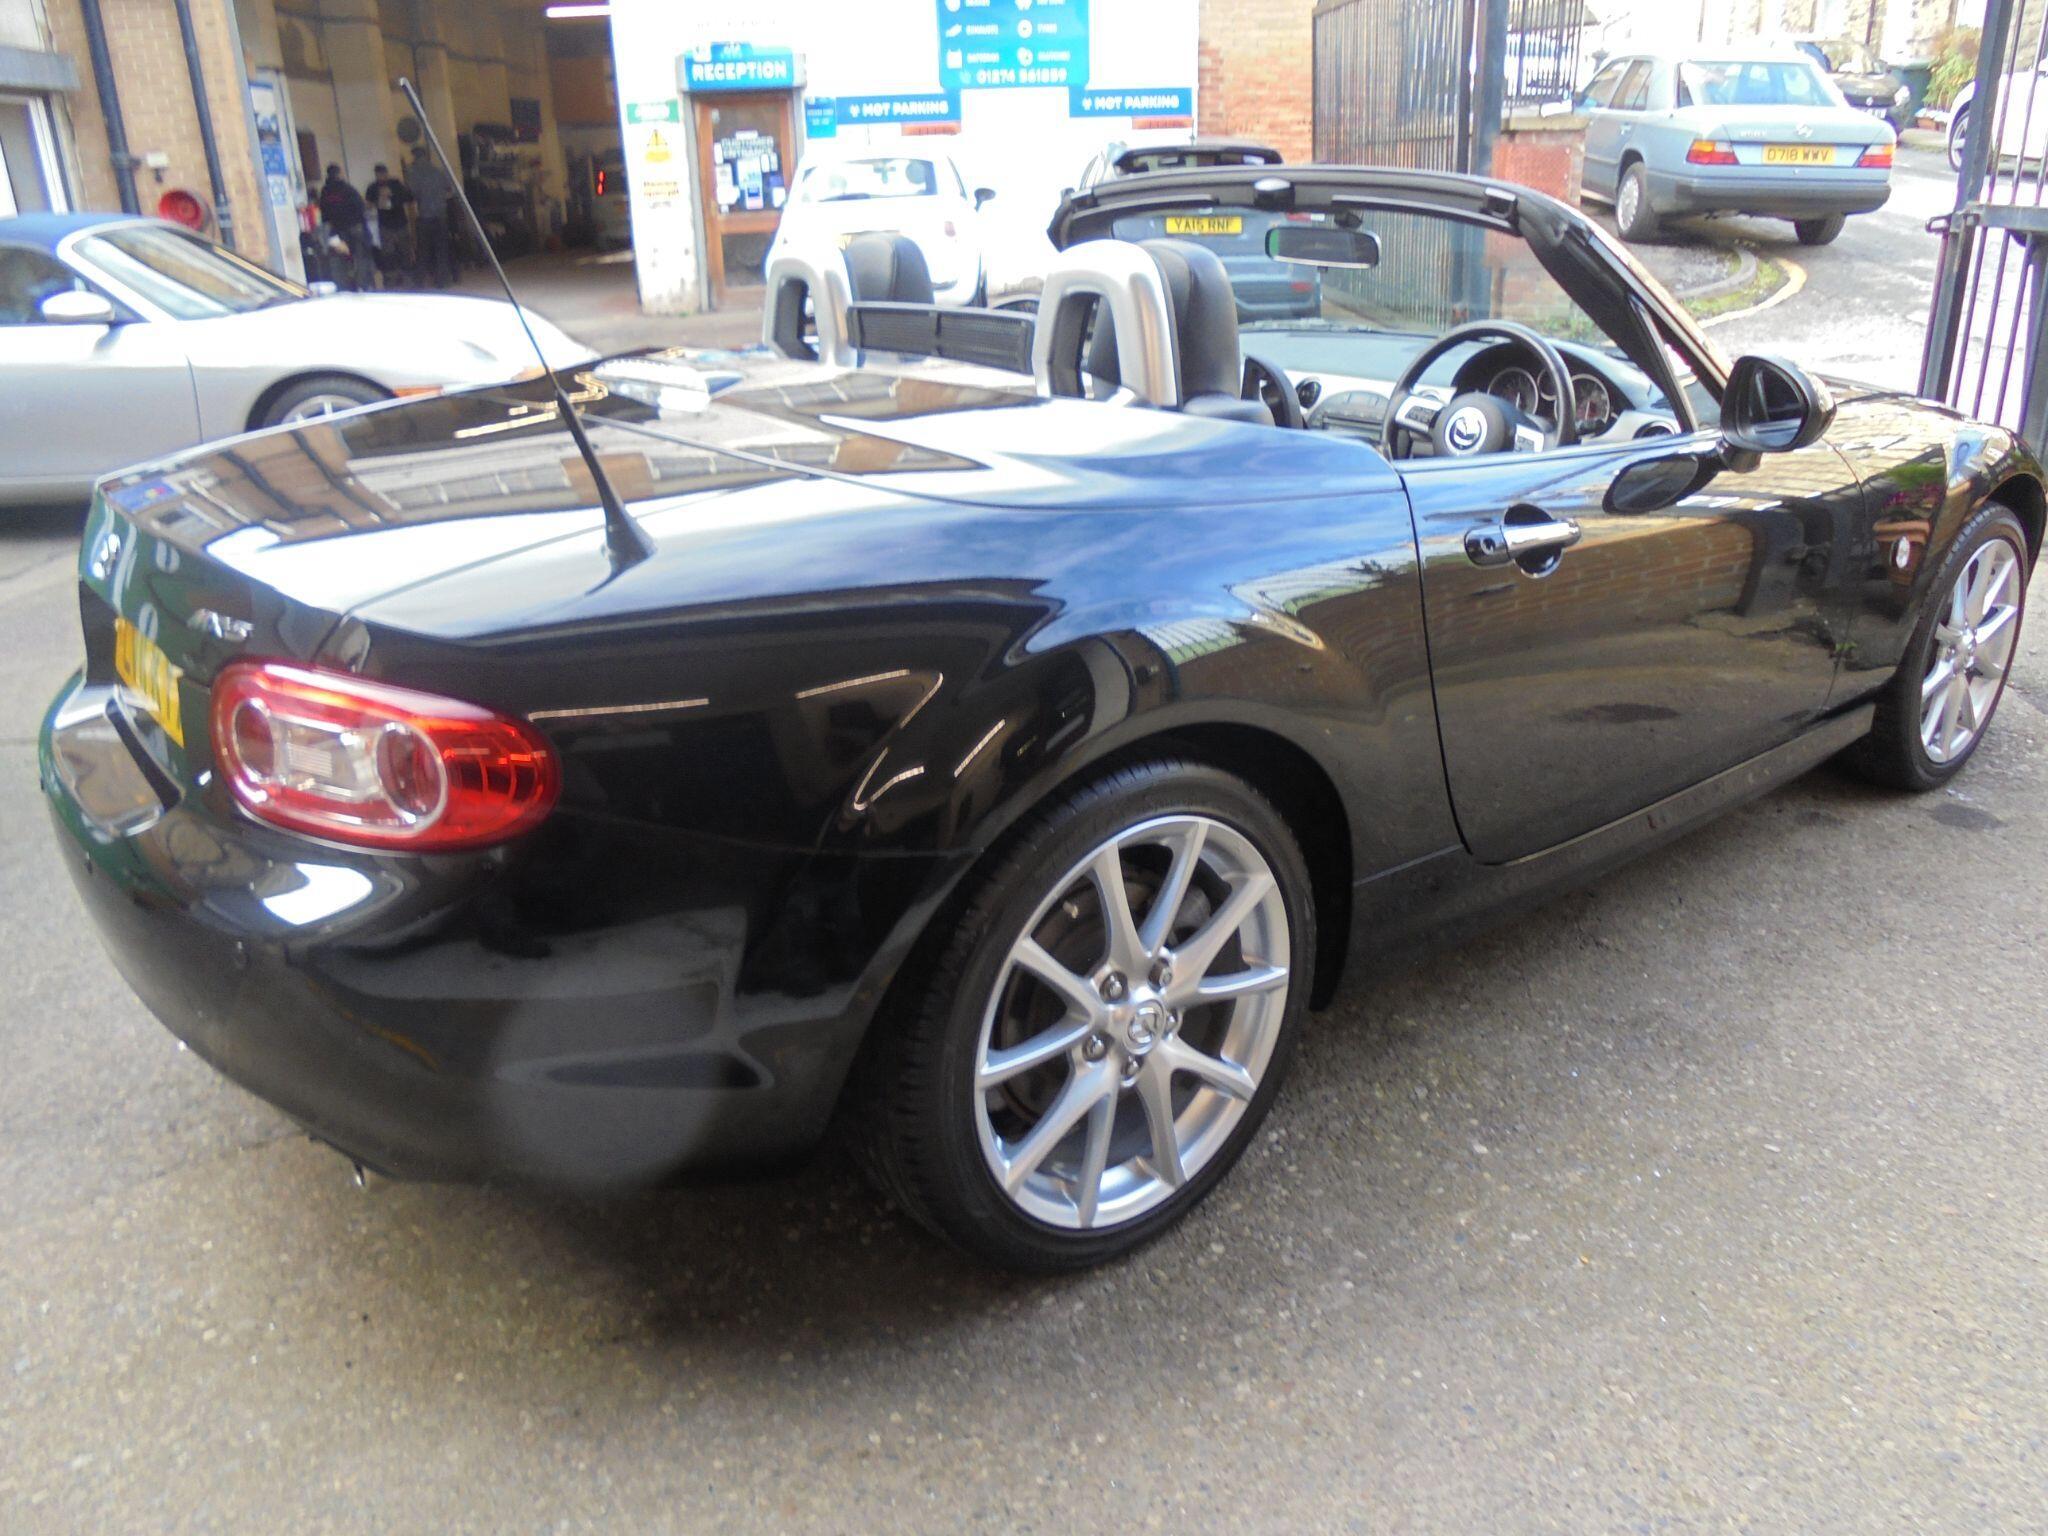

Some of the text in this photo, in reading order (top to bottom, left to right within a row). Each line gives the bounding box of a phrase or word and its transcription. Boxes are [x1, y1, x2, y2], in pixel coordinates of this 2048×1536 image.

[692, 60, 788, 81] RECEPTION
[862, 100, 949, 117] MOT PARKING
[1094, 94, 1180, 111] MOT PARKING
